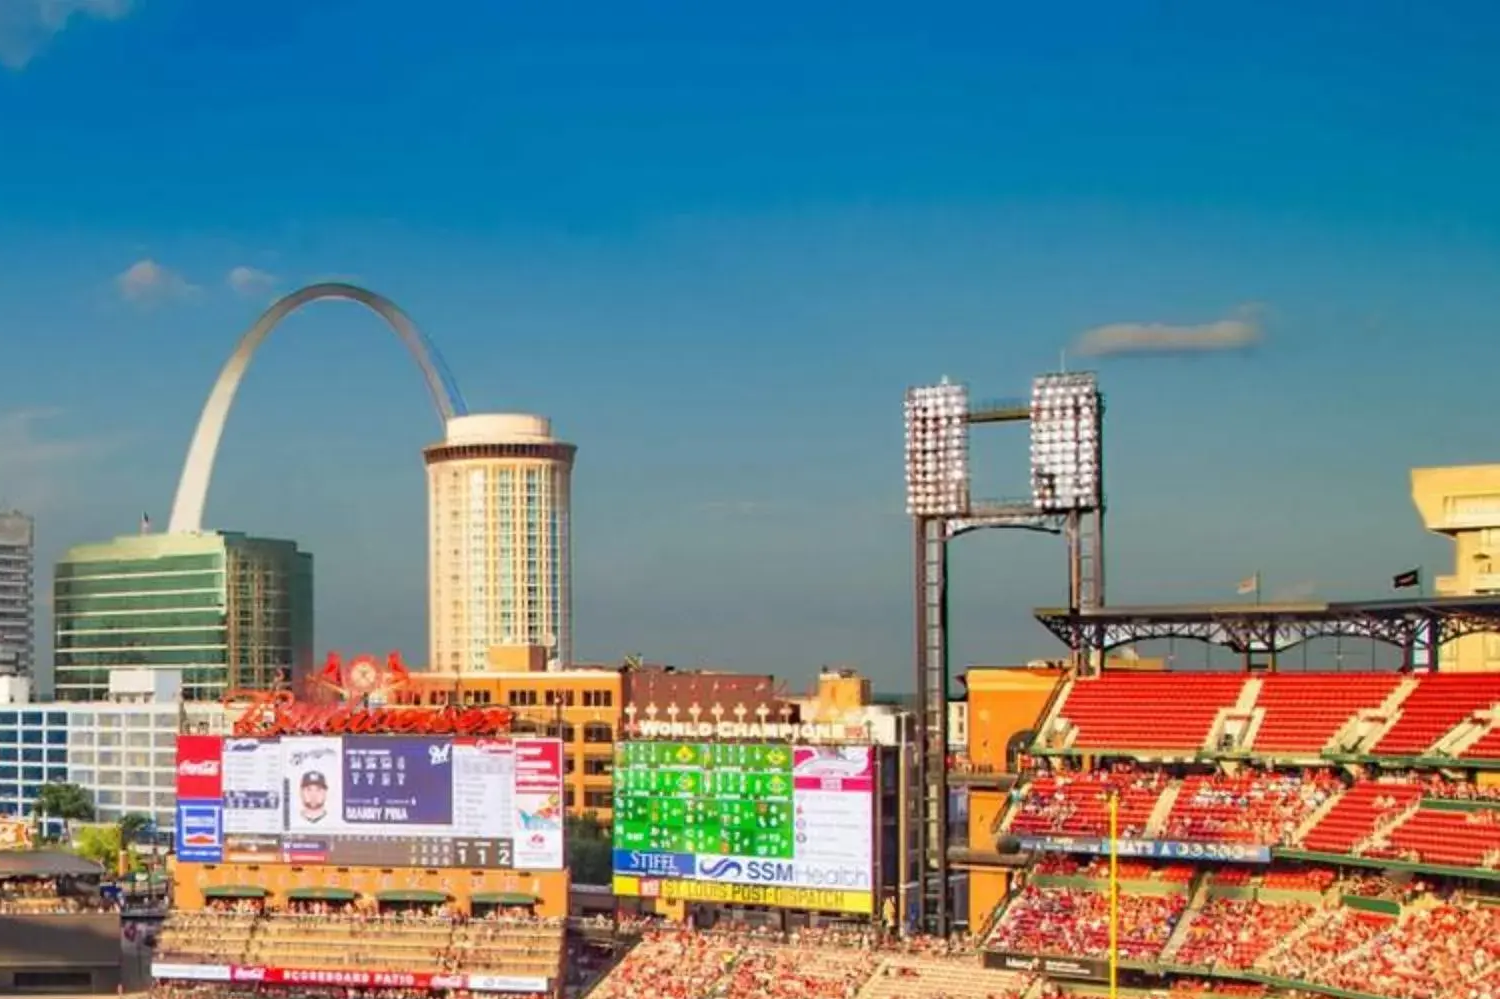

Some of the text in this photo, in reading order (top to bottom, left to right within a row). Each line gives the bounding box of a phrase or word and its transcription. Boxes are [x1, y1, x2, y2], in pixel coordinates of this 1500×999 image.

[640, 721, 713, 737] WORLD
[499, 849, 510, 865] 2
[630, 851, 675, 870] STIFEL
[746, 860, 868, 888] SSM Health
[283, 970, 414, 985] SCOREBOARD PATIO
